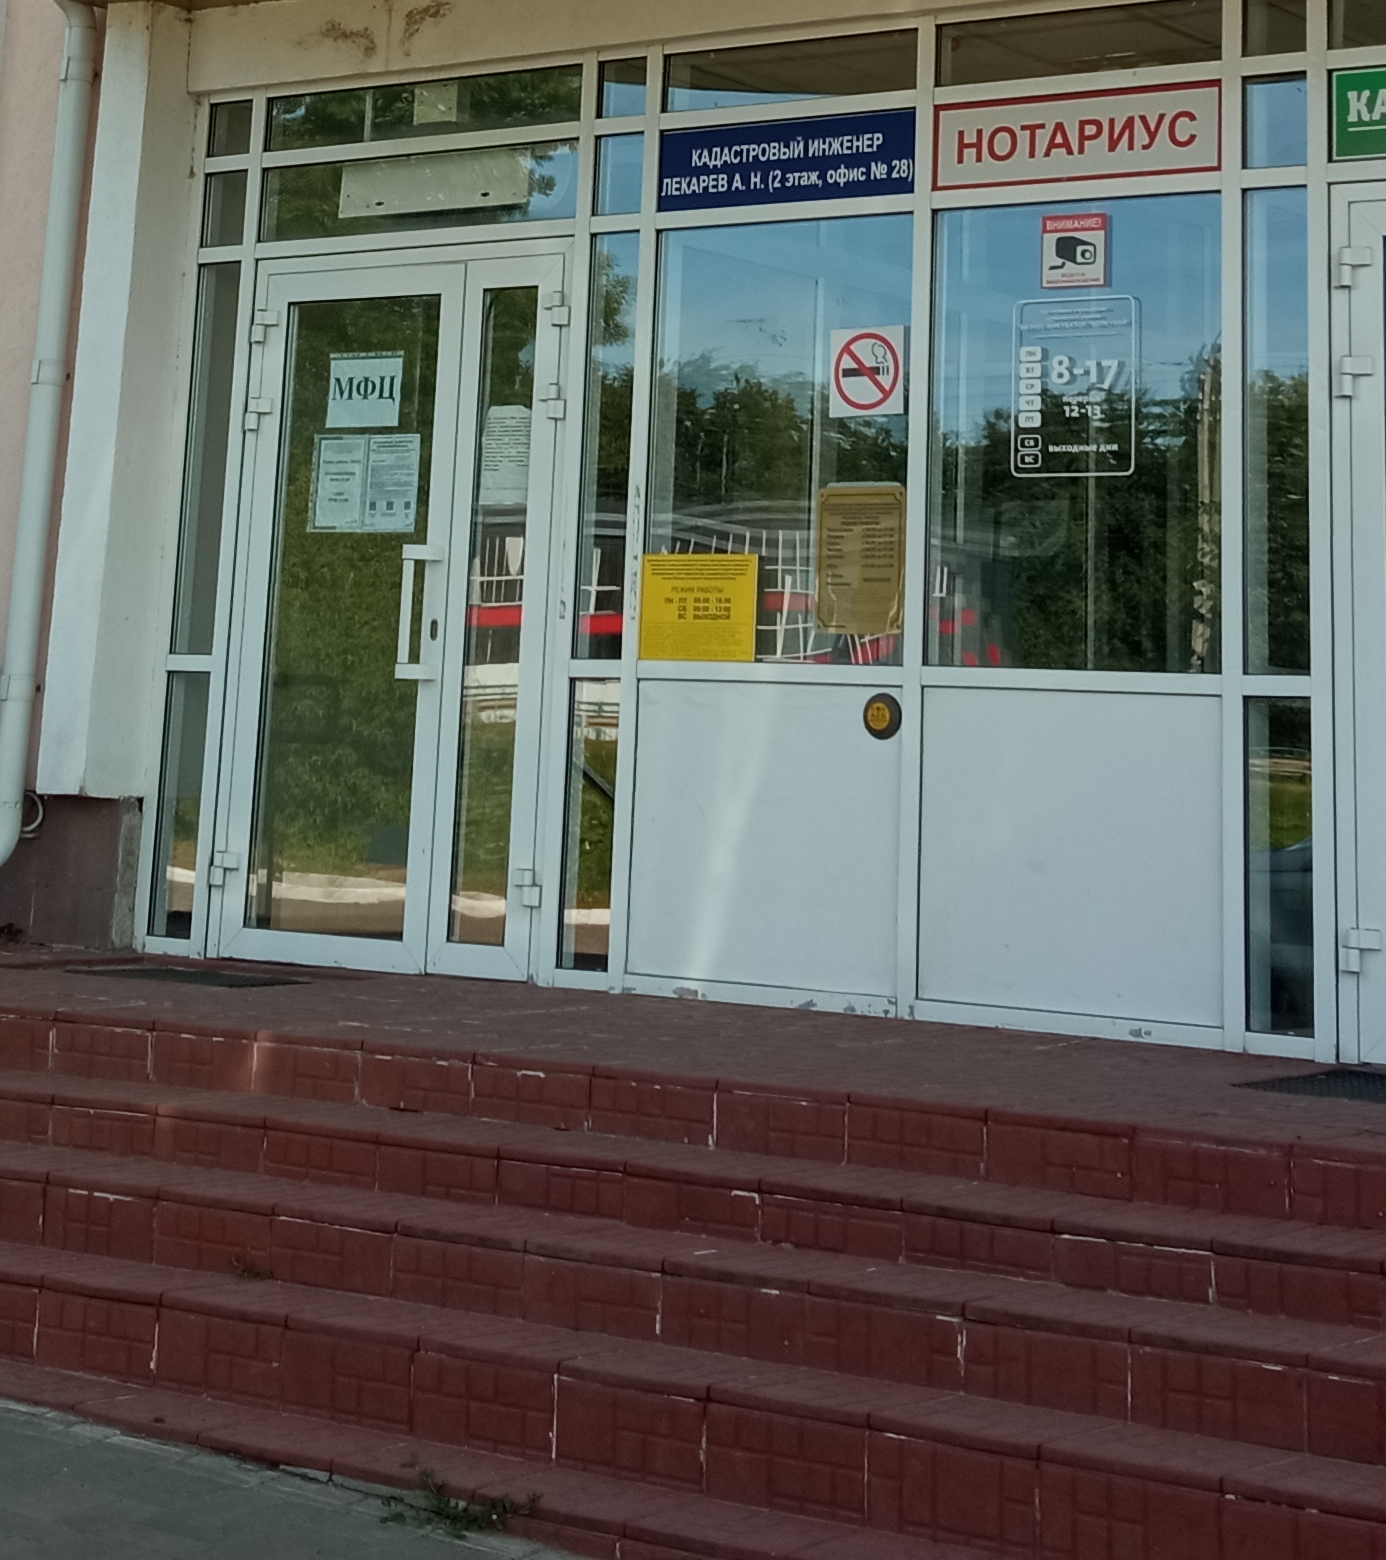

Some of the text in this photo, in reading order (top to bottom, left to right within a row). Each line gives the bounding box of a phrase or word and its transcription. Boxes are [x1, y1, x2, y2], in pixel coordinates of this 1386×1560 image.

[691, 132, 883, 169] КАДАСТРОВЫЙ ИНЖЕНЕР
[956, 110, 1198, 165] НОТАРИУС
[661, 158, 913, 197] ЛЕКАРЕВ А. Н. (2 этаж, офис № 28)
[1045, 217, 1102, 231] ВНИМАНИЕ!
[332, 375, 397, 405] МФЦ
[1050, 354, 1119, 390] 8-17
